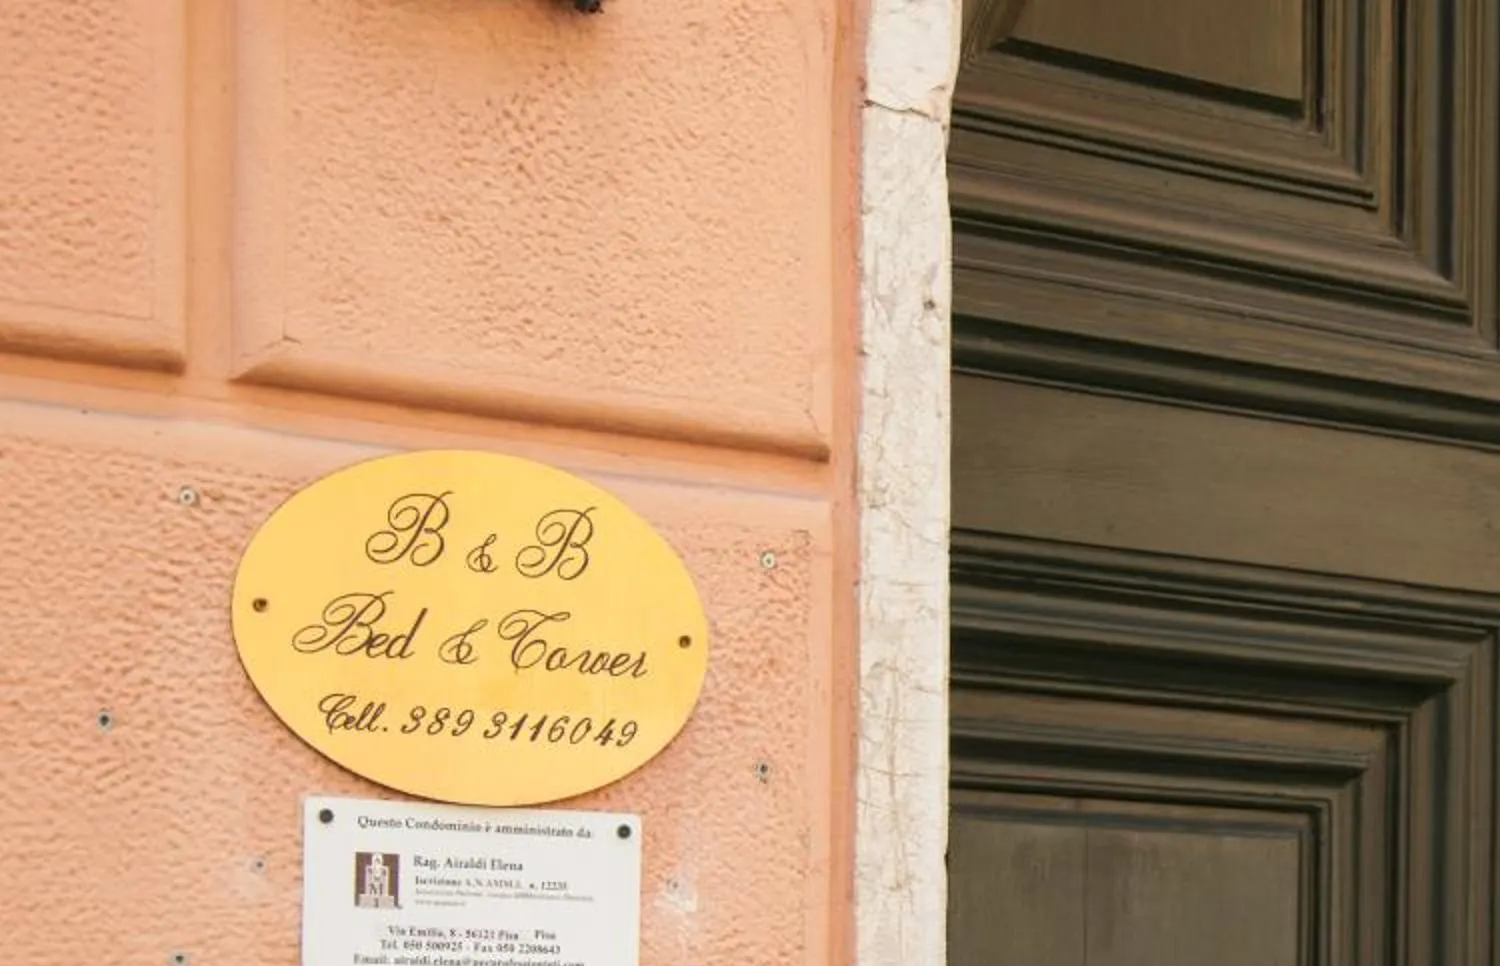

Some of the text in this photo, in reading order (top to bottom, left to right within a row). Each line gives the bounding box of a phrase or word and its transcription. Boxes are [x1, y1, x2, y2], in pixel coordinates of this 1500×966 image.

[365, 491, 598, 580] B & B
[292, 591, 648, 678] Bed & Tower
[318, 693, 639, 748] Cell. 389 3116049
[358, 815, 401, 830] Questo
[405, 817, 482, 833] Condominio
[494, 824, 574, 838] amministrato
[414, 855, 524, 872] Rag. Airaldi Elena
[388, 925, 406, 937] Via
[474, 942, 493, 953] Fax
